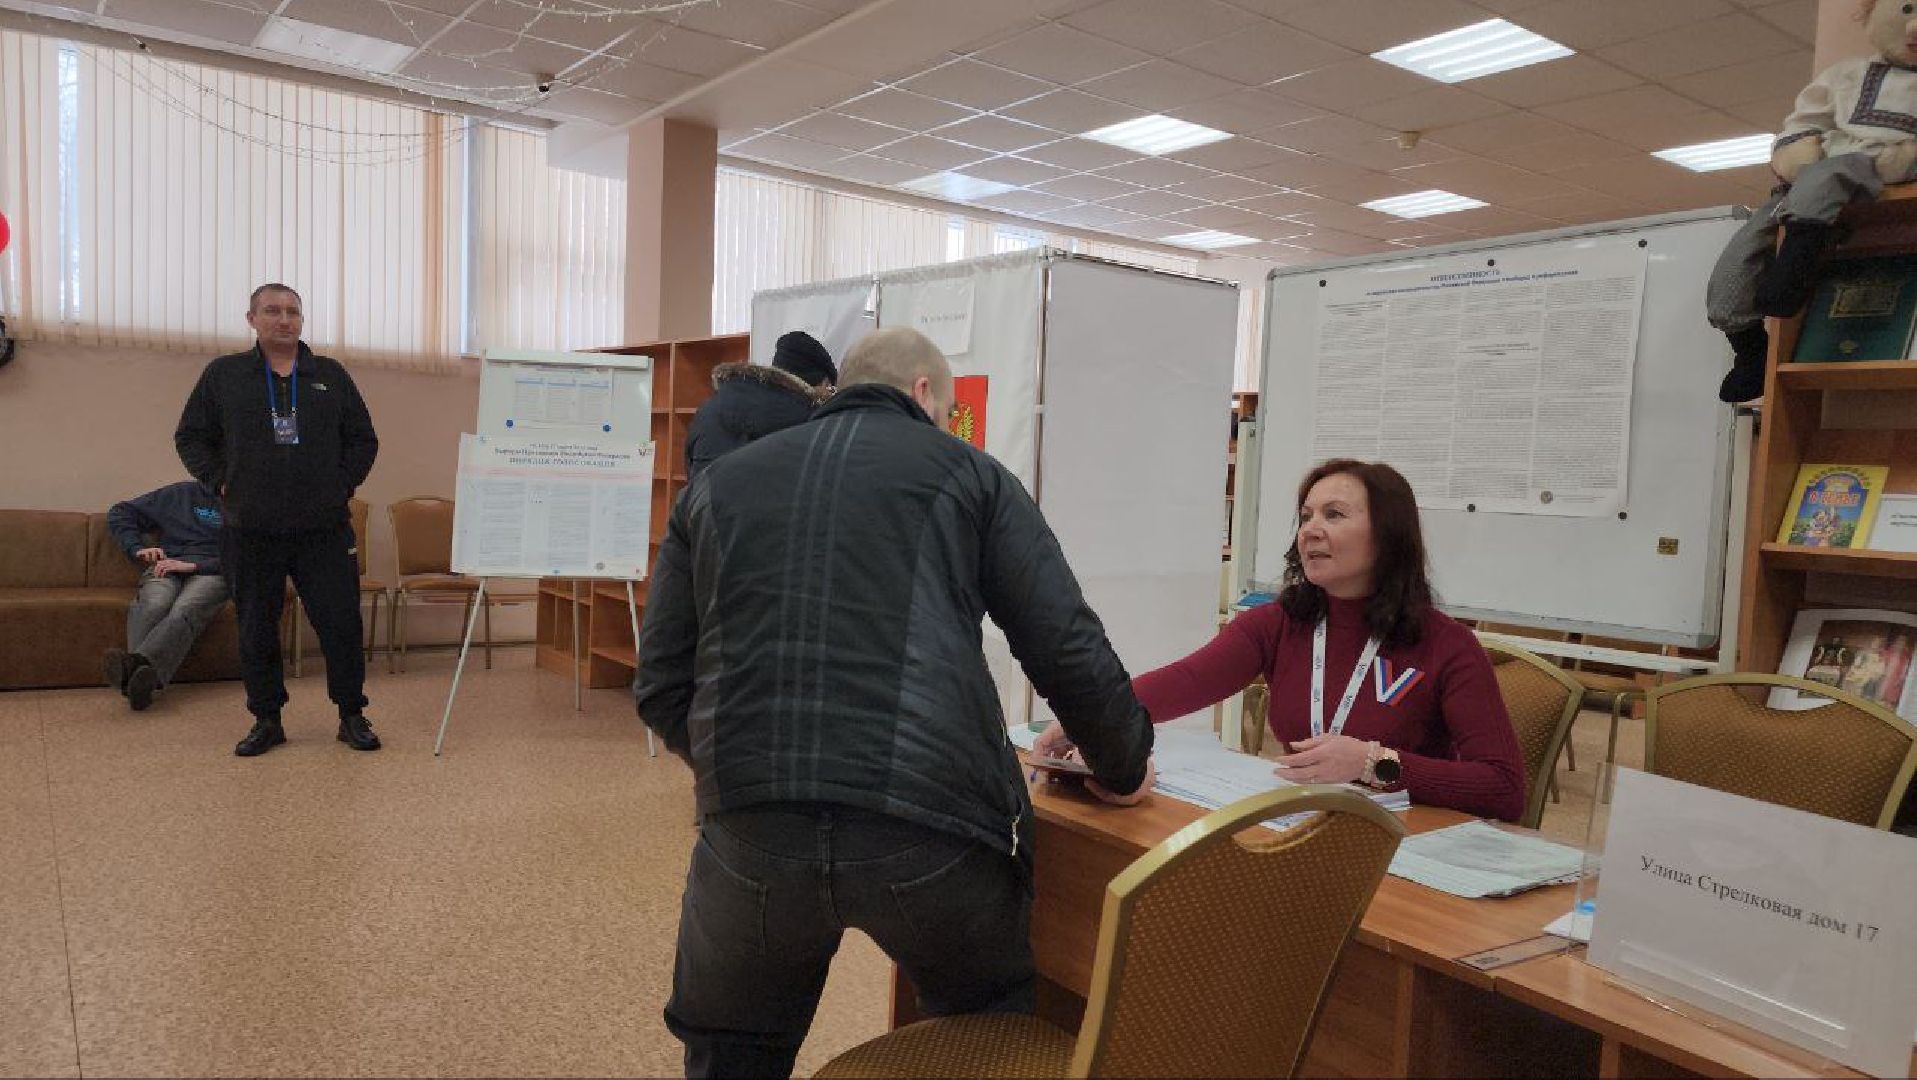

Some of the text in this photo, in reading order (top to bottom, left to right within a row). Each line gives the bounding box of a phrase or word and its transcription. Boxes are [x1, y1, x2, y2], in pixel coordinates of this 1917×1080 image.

[1641, 855, 1880, 942] Улица Стрелковая дом 17
